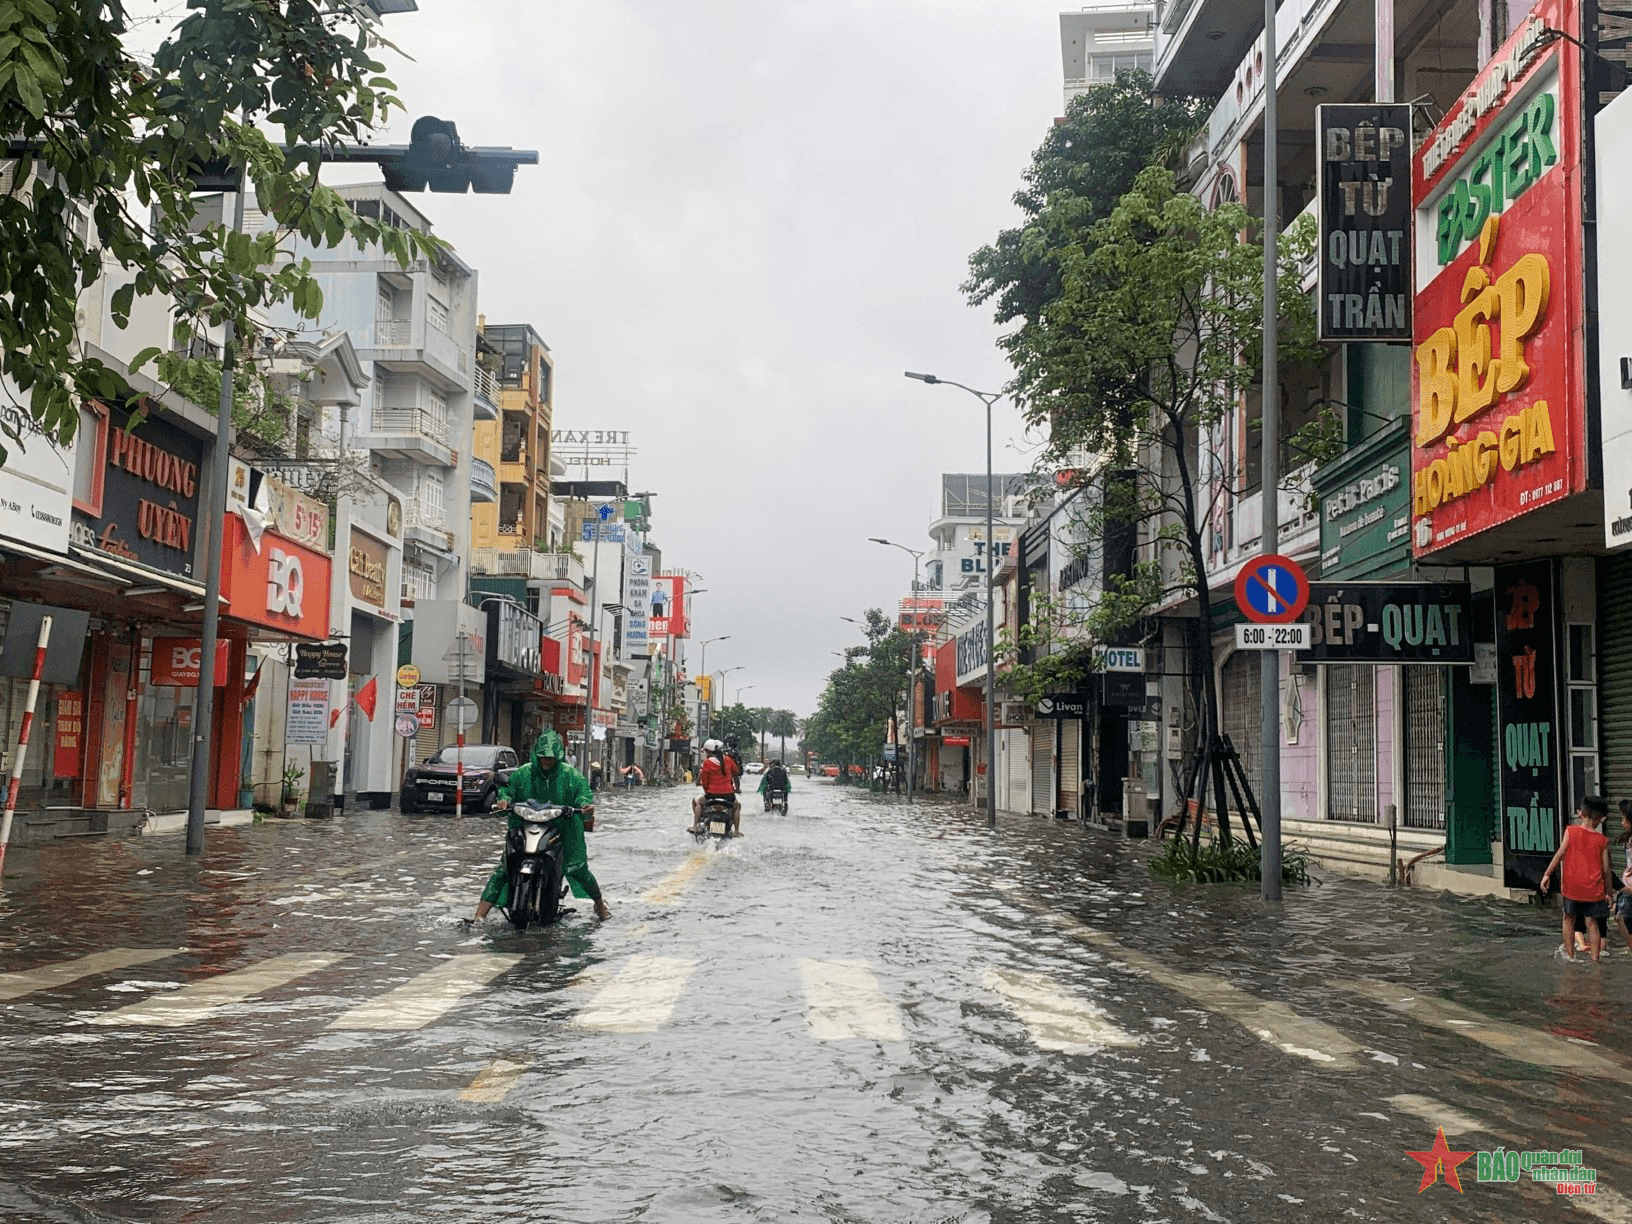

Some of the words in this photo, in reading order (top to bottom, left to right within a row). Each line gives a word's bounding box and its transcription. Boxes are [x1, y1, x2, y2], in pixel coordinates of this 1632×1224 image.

[1326, 117, 1405, 162] BẾP
[1339, 173, 1393, 216] TỪ
[1329, 229, 1403, 273] QUẠT
[1328, 282, 1405, 329] TRẦN
[1416, 214, 1549, 448] BẾP
[1415, 431, 1499, 516] HOÀNG
[1499, 400, 1556, 471] GIA
[1359, 463, 1400, 502] Paris
[973, 541, 1012, 556] THE
[1243, 628, 1265, 644] 6:00
[1275, 628, 1302, 644] 22:00
[1056, 702, 1083, 711] Livan
[1505, 721, 1550, 777] QUẠT
[1507, 792, 1555, 853] TRẦN
